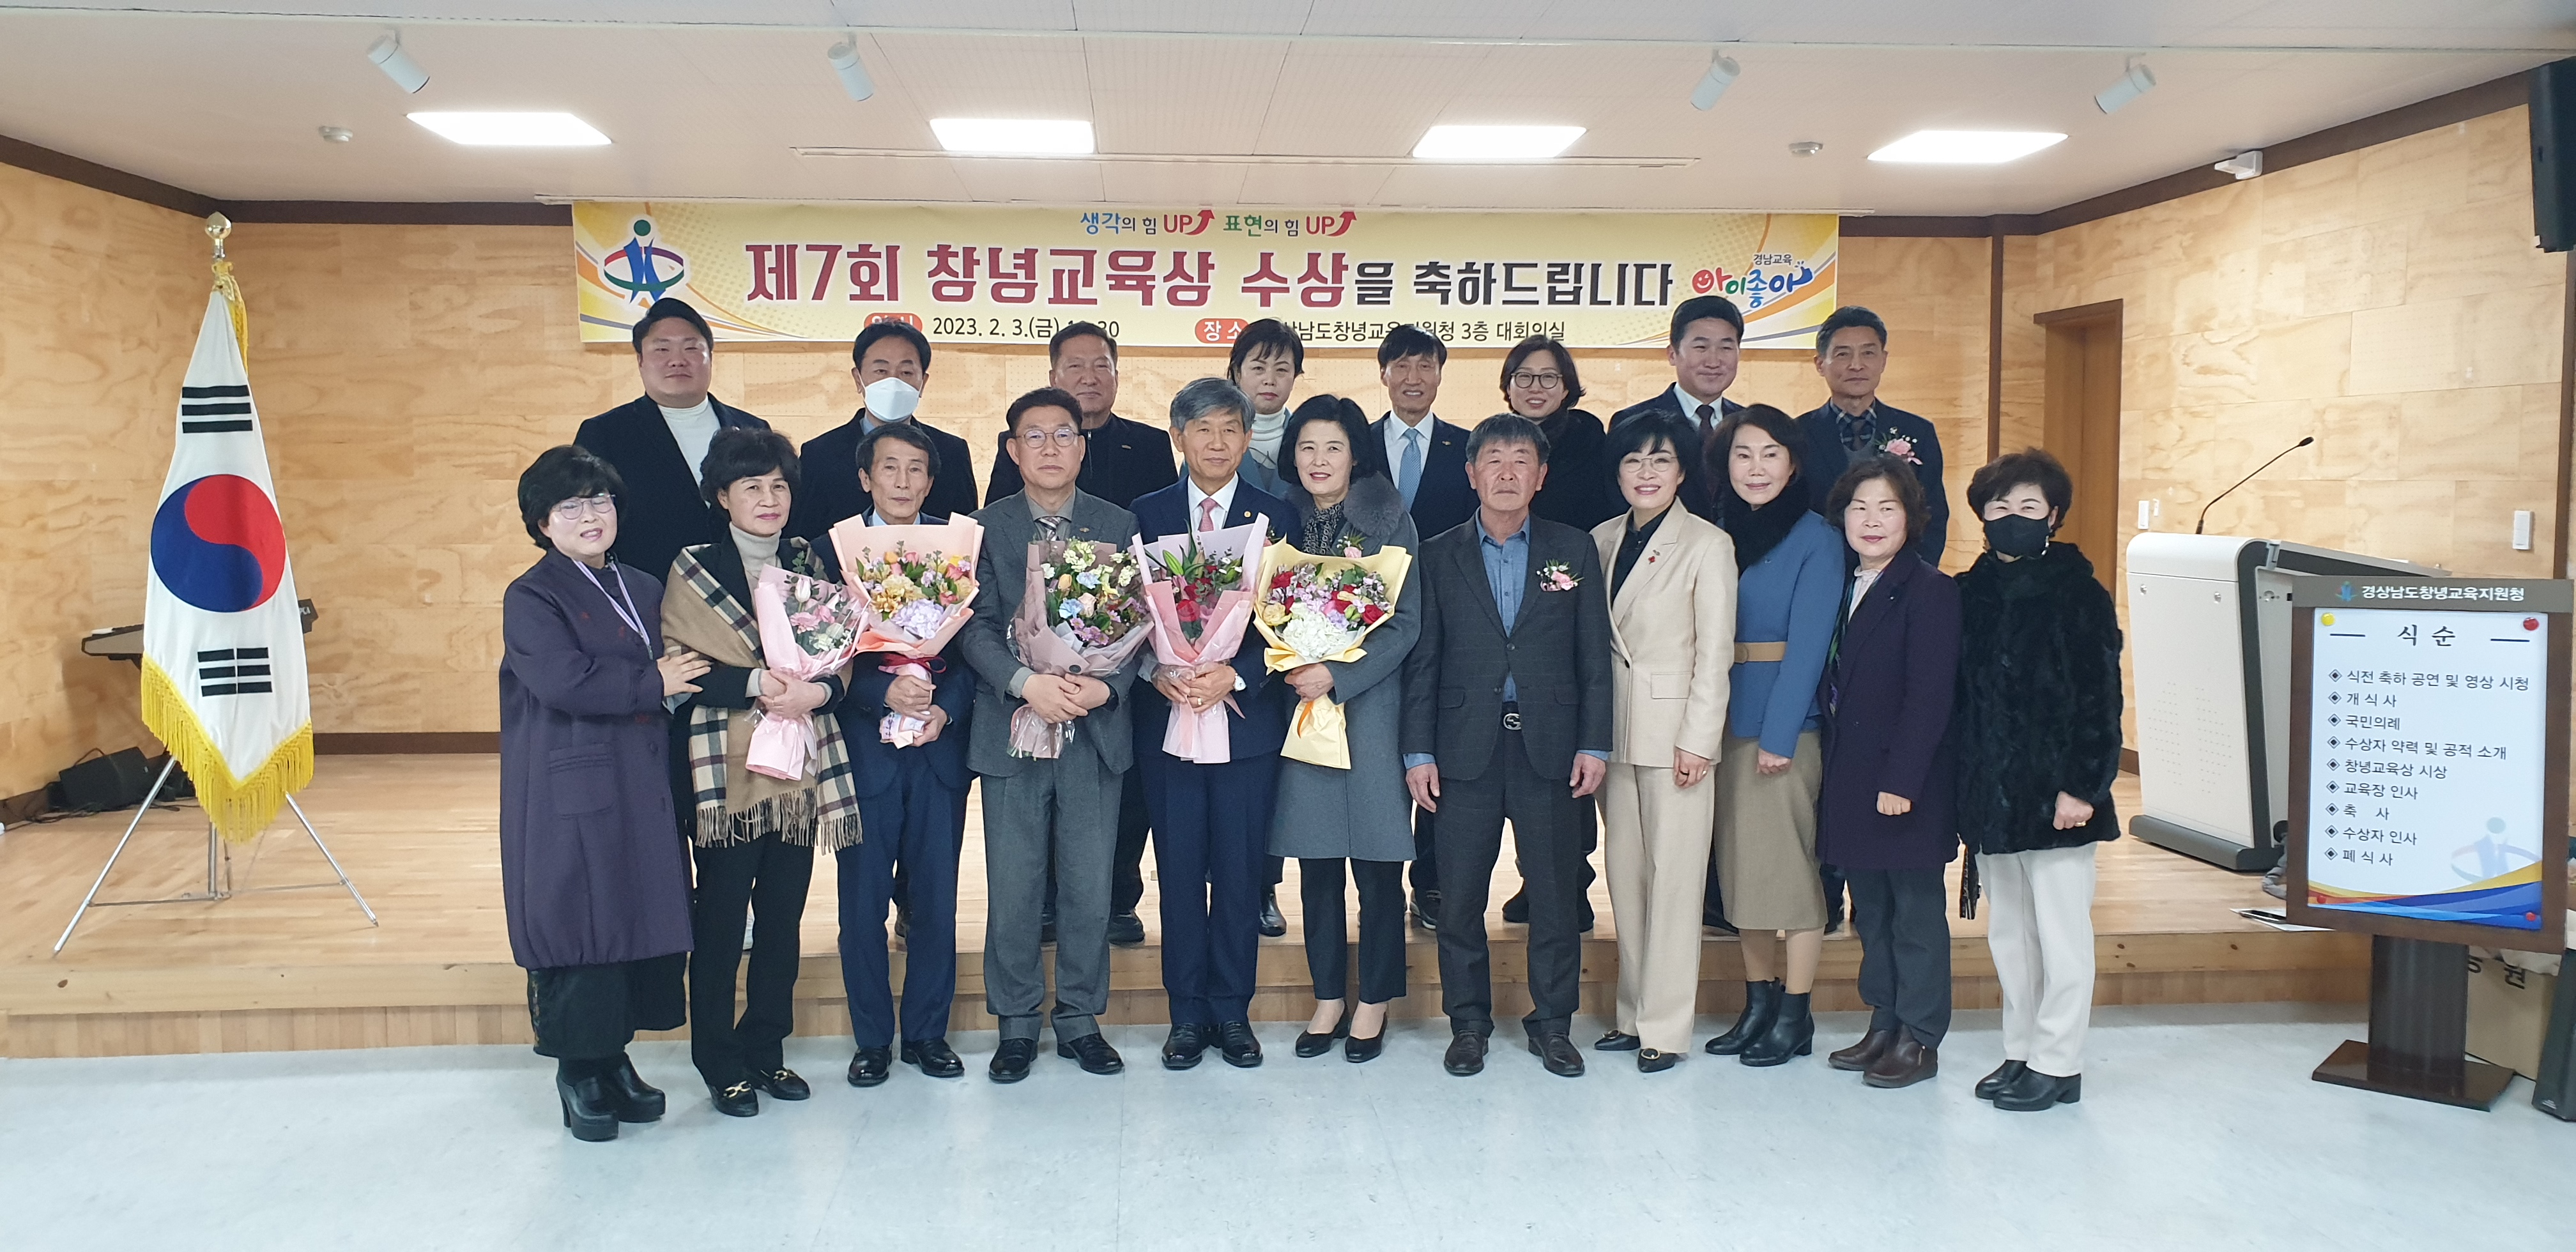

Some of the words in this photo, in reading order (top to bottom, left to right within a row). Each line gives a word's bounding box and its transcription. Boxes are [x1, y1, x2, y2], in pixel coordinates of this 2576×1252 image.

[1080, 213, 1136, 234] 생각의
[1142, 217, 1156, 234] 힘
[1163, 215, 1193, 233] UP
[1223, 215, 1278, 236] 표현의
[1285, 219, 1299, 236] 힘
[1307, 216, 1335, 234] UP
[1753, 254, 1792, 265] 경남교육
[746, 244, 900, 302] 제7회
[927, 244, 1215, 307] 창녕교육상
[1241, 252, 1393, 308] 수상을
[1413, 261, 1673, 305] 축하드립니다
[1692, 266, 1813, 308] 아이좋아
[933, 317, 982, 337] 2023.
[990, 319, 1005, 337] 2.
[1012, 317, 1059, 339] 3.(금)
[1461, 321, 1489, 341] 3층
[1496, 321, 1565, 341] 대회의실
[2361, 585, 2524, 601] 경상남도창녕교육지원청
[2347, 671, 2374, 684] 식전
[2379, 673, 2406, 685] 축하
[2412, 673, 2439, 687] 공연
[2446, 675, 2458, 688] 및
[2465, 675, 2493, 689] 영상
[2499, 676, 2529, 691] 시청
[2345, 715, 2400, 730] 국민의례
[2345, 738, 2386, 752] 수상자
[2391, 740, 2418, 754] 약력
[2425, 742, 2437, 755] 및
[2442, 744, 2472, 758] 공적
[2477, 746, 2507, 760] 소개
[2344, 760, 2413, 777] 창녕교육상
[2419, 765, 2447, 779] 시상
[2343, 782, 2385, 797] 교육장
[2391, 785, 2418, 800] 인사
[2343, 827, 2384, 841] 수상자
[2389, 830, 2417, 844] 인사
